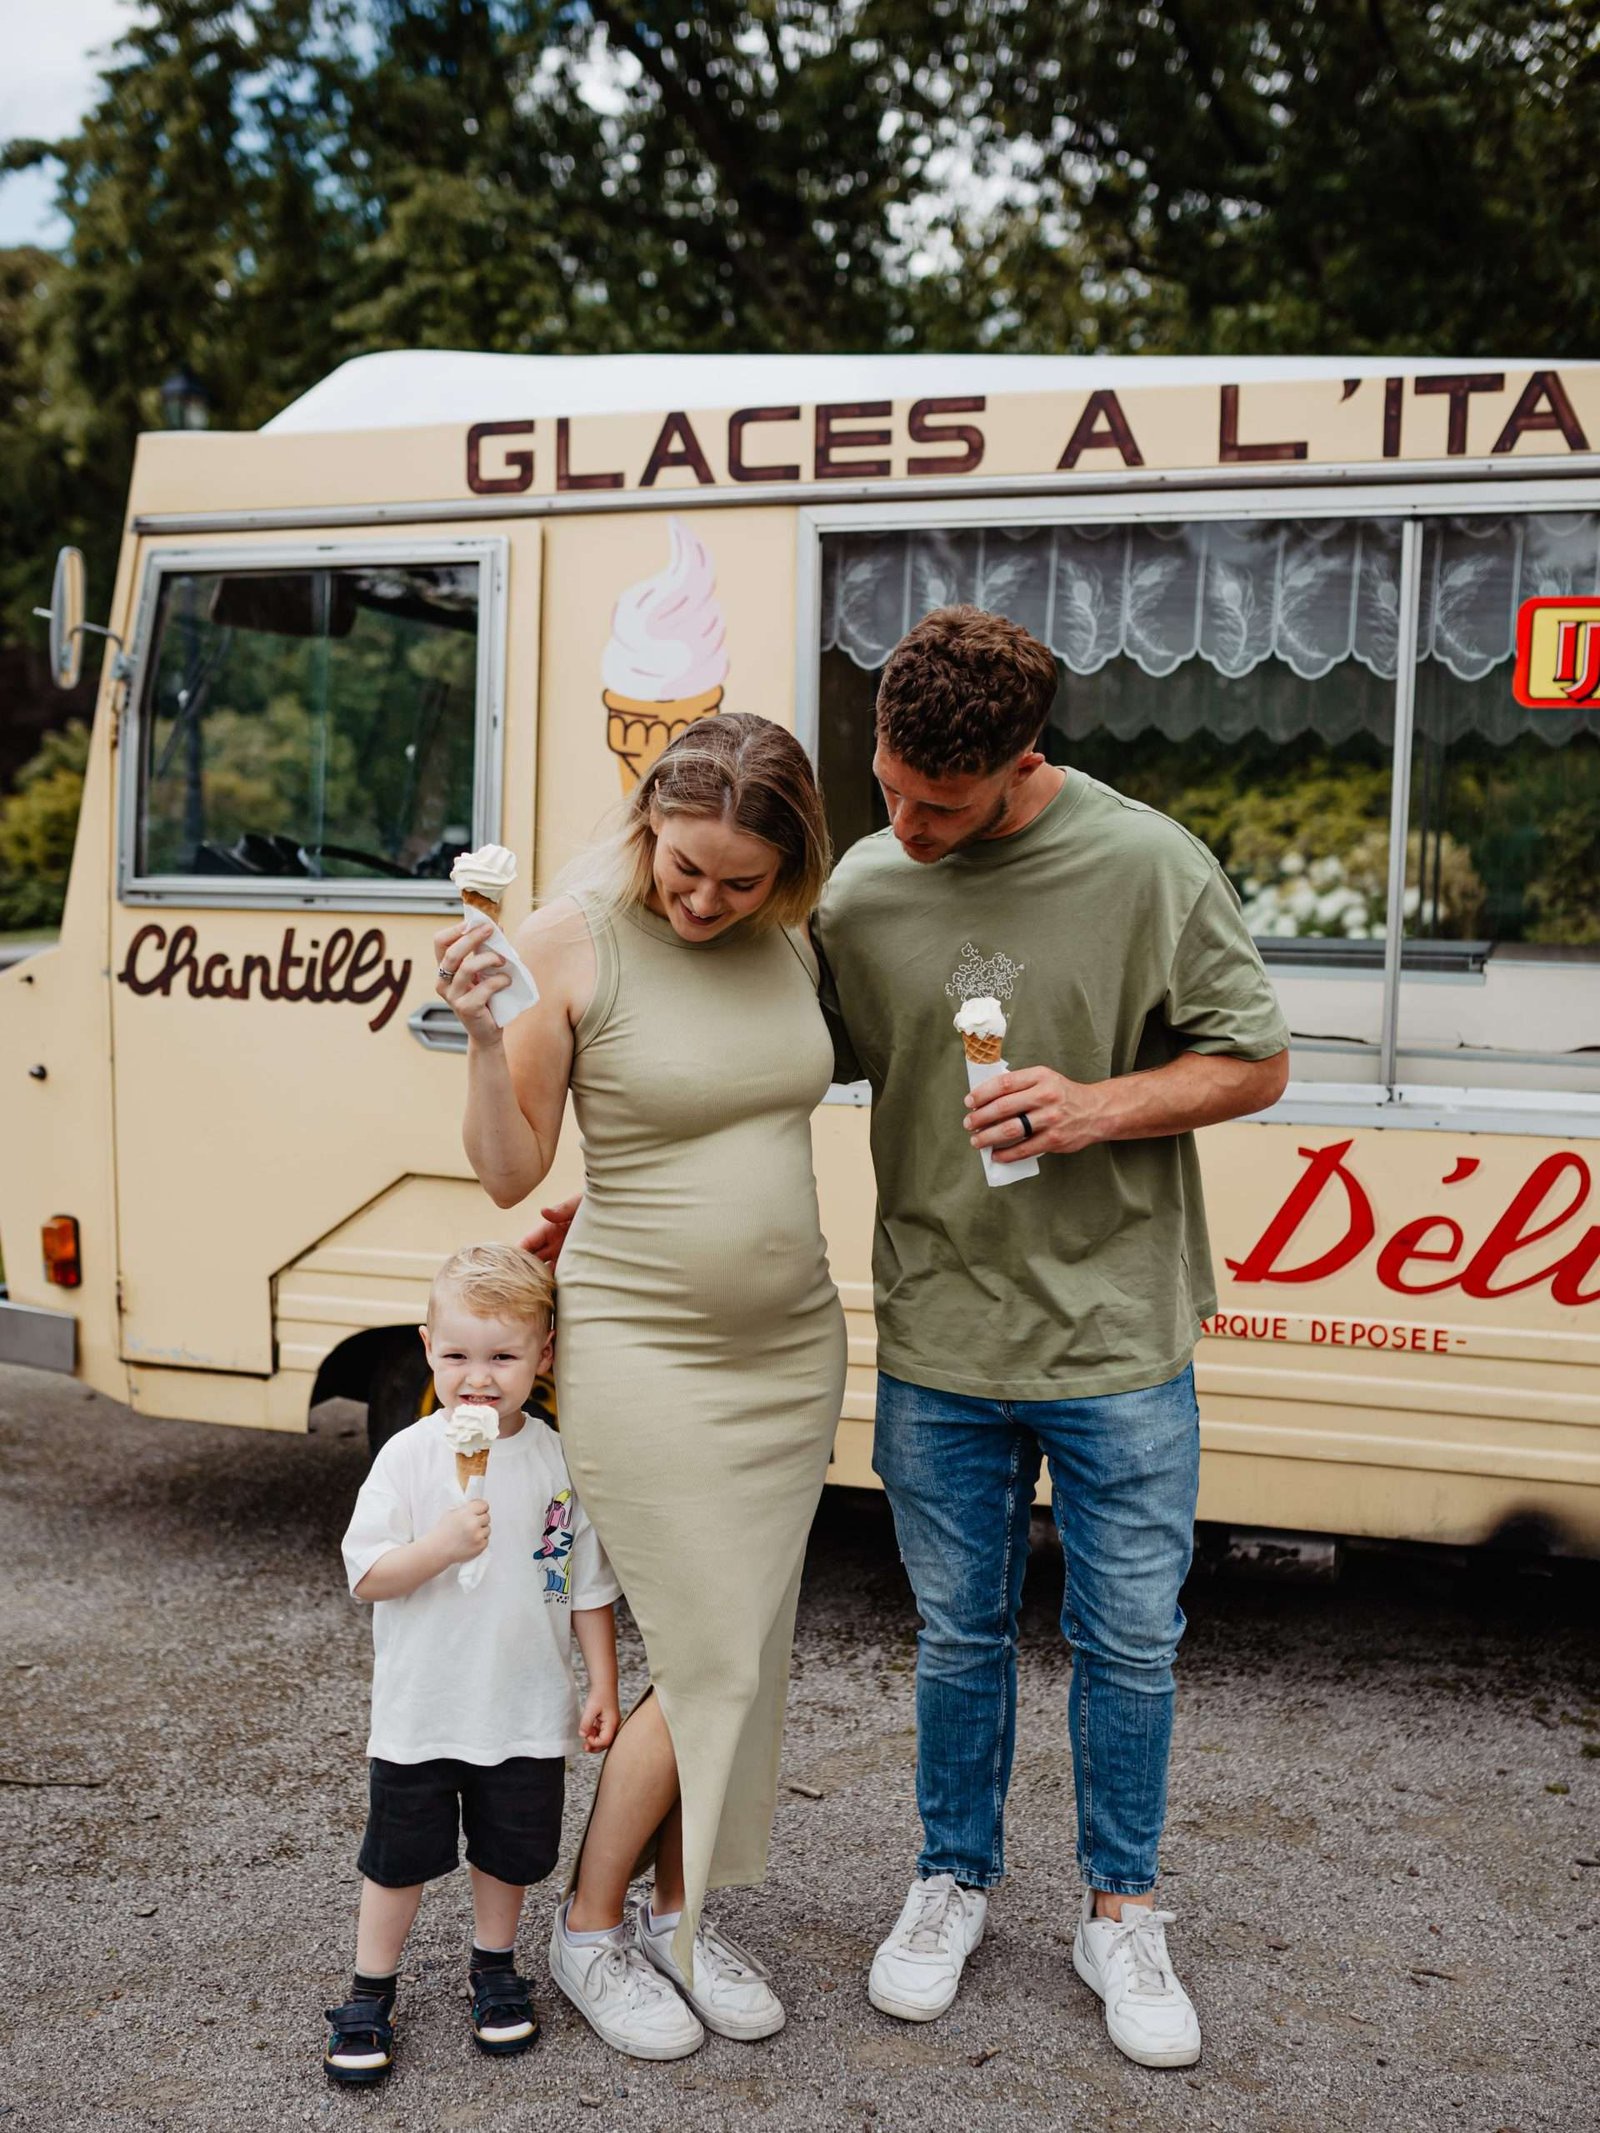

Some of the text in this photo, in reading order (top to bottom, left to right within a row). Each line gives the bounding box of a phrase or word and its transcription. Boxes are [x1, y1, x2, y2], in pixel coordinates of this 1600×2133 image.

[466, 395, 987, 495] GLACES
[1055, 389, 1146, 470] A
[117, 923, 413, 1033] Chantilly
